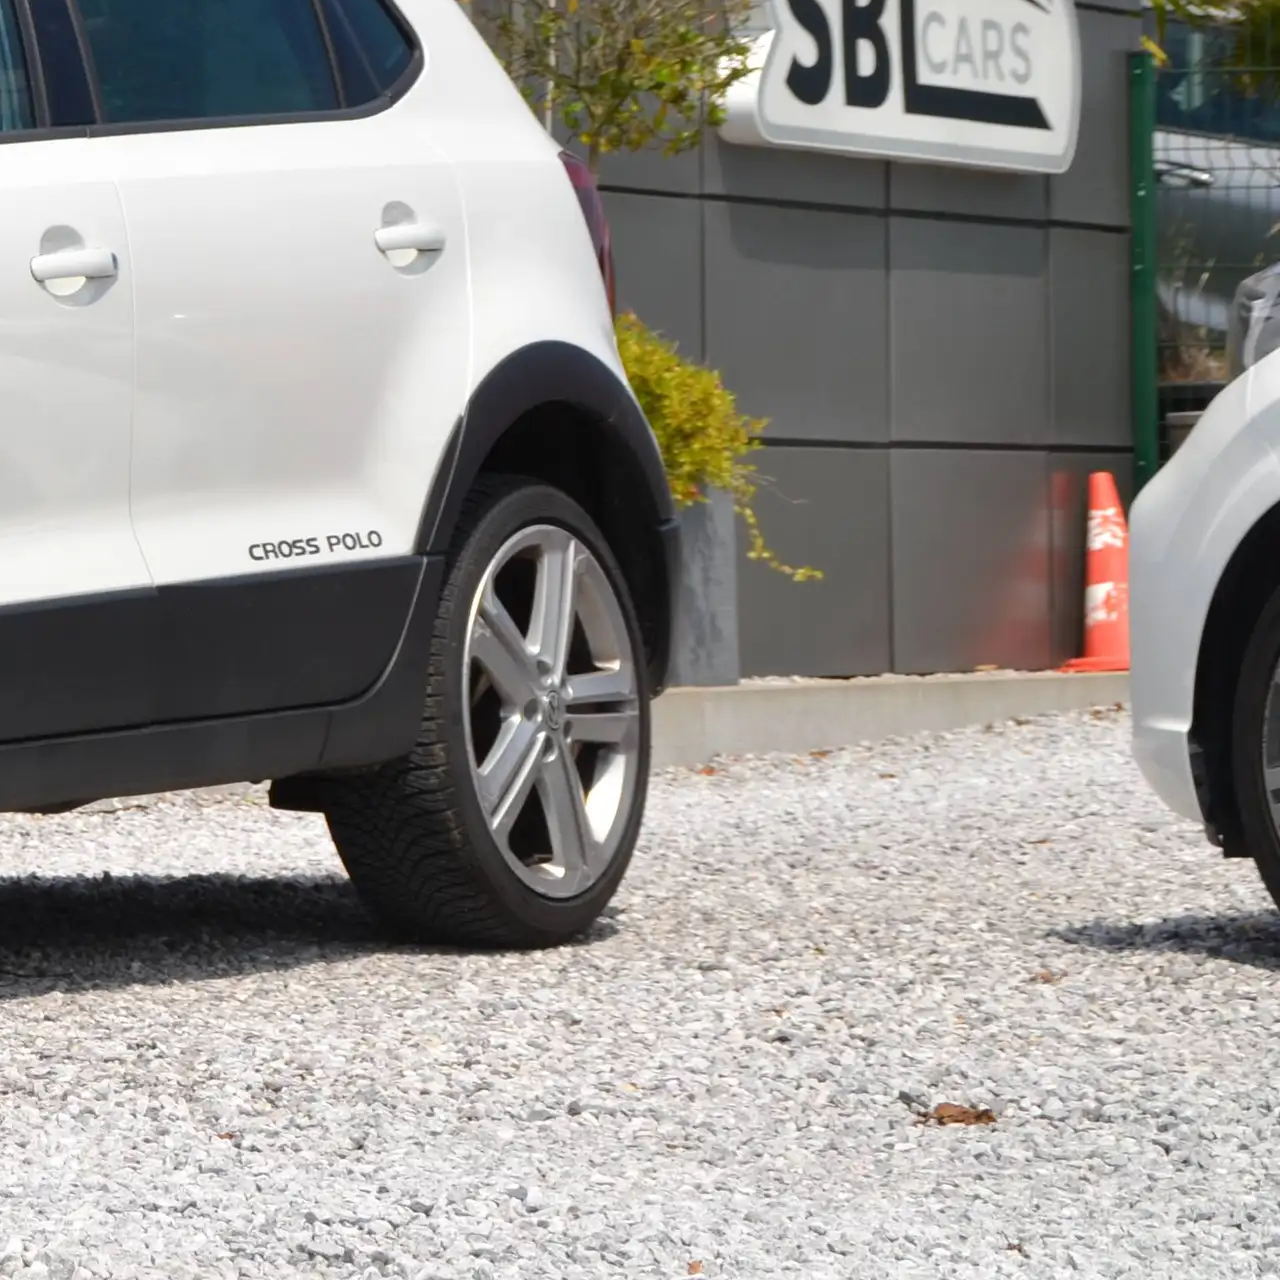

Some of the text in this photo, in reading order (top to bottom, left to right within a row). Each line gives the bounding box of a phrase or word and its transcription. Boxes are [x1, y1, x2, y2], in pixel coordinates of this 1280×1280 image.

[921, 10, 1032, 85] CARS
[248, 529, 383, 561] CROSS POLO
